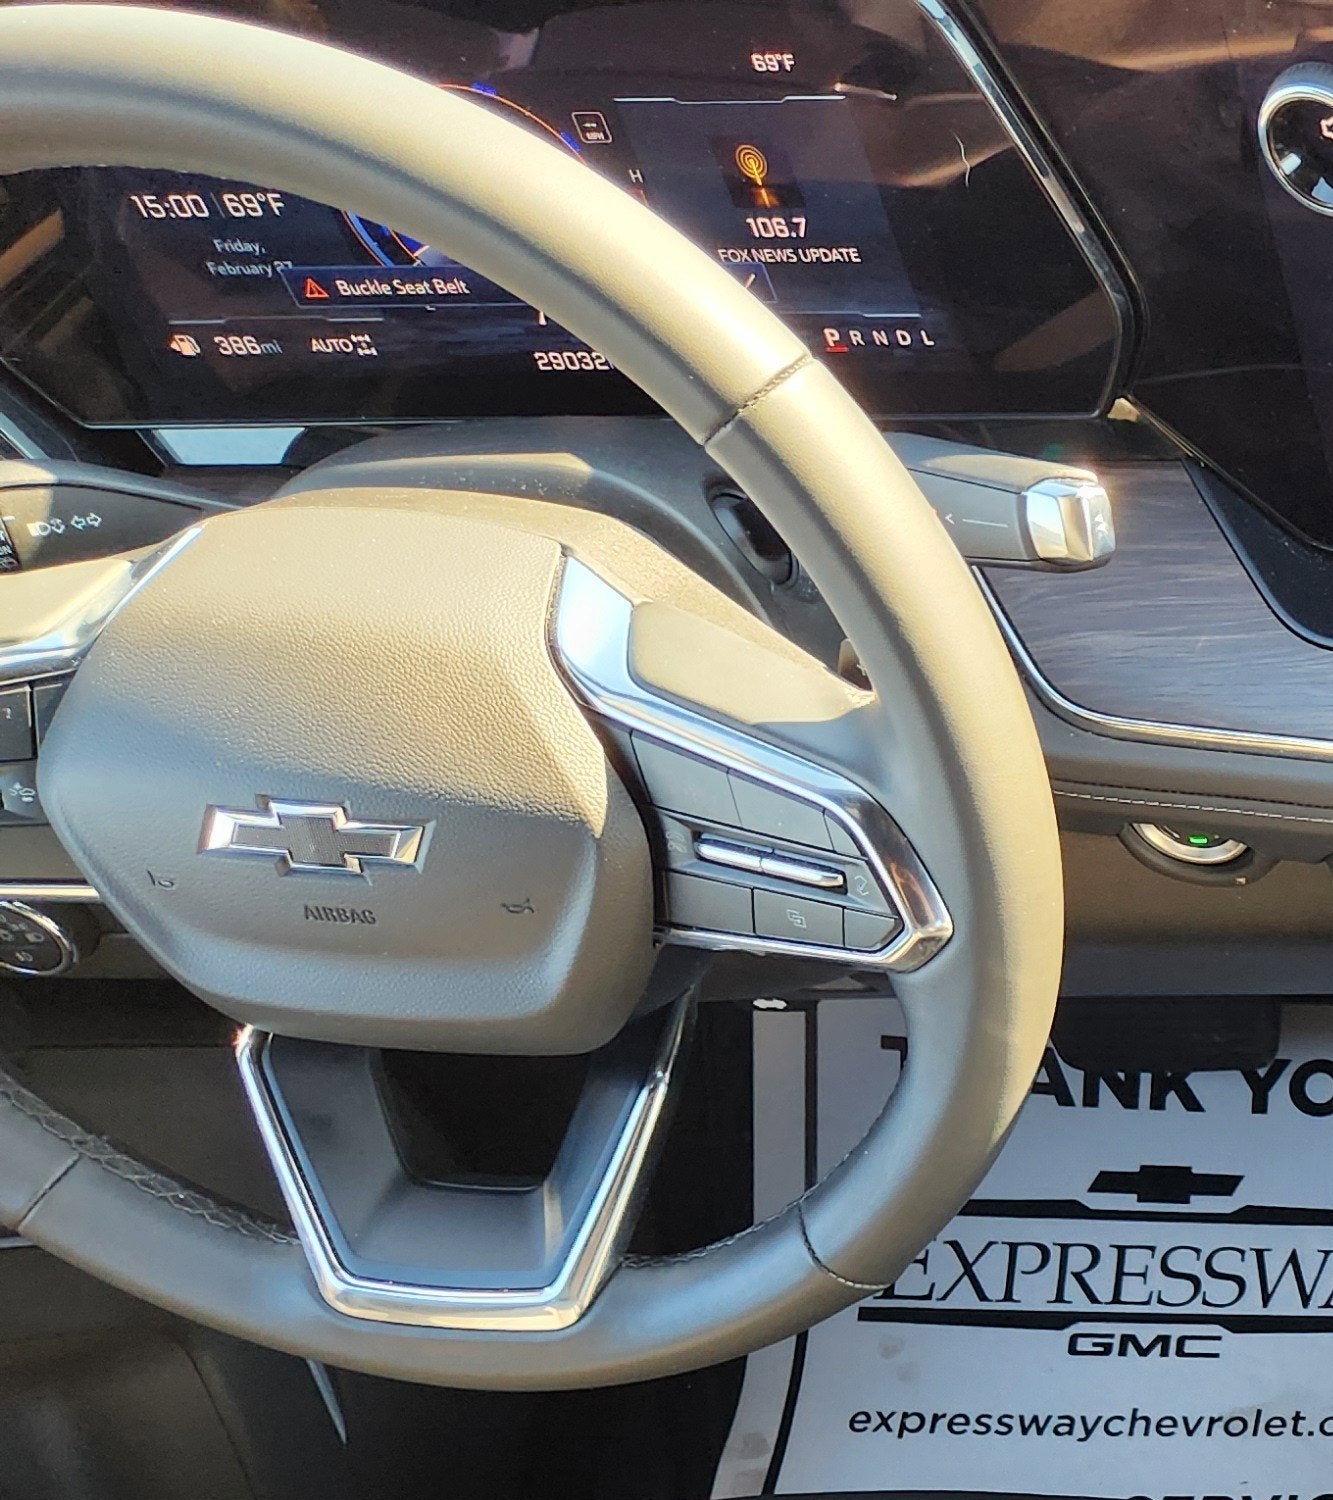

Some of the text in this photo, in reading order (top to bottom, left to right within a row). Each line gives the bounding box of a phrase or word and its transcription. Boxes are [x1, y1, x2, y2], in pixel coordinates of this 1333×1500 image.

[750, 53, 795, 72] 69°F
[130, 192, 286, 219] 15:00 69°F
[745, 216, 807, 239] 106.7
[212, 238, 266, 256] Friday,
[717, 248, 862, 263] FOX NEWS UPDATE
[205, 260, 272, 279] February
[335, 277, 471, 296] Buckle Seat Belt
[310, 337, 353, 354] AUTO
[823, 328, 936, 347] P R N D L
[304, 904, 377, 925] AIRBAG
[1066, 1332, 1223, 1359] GMC
